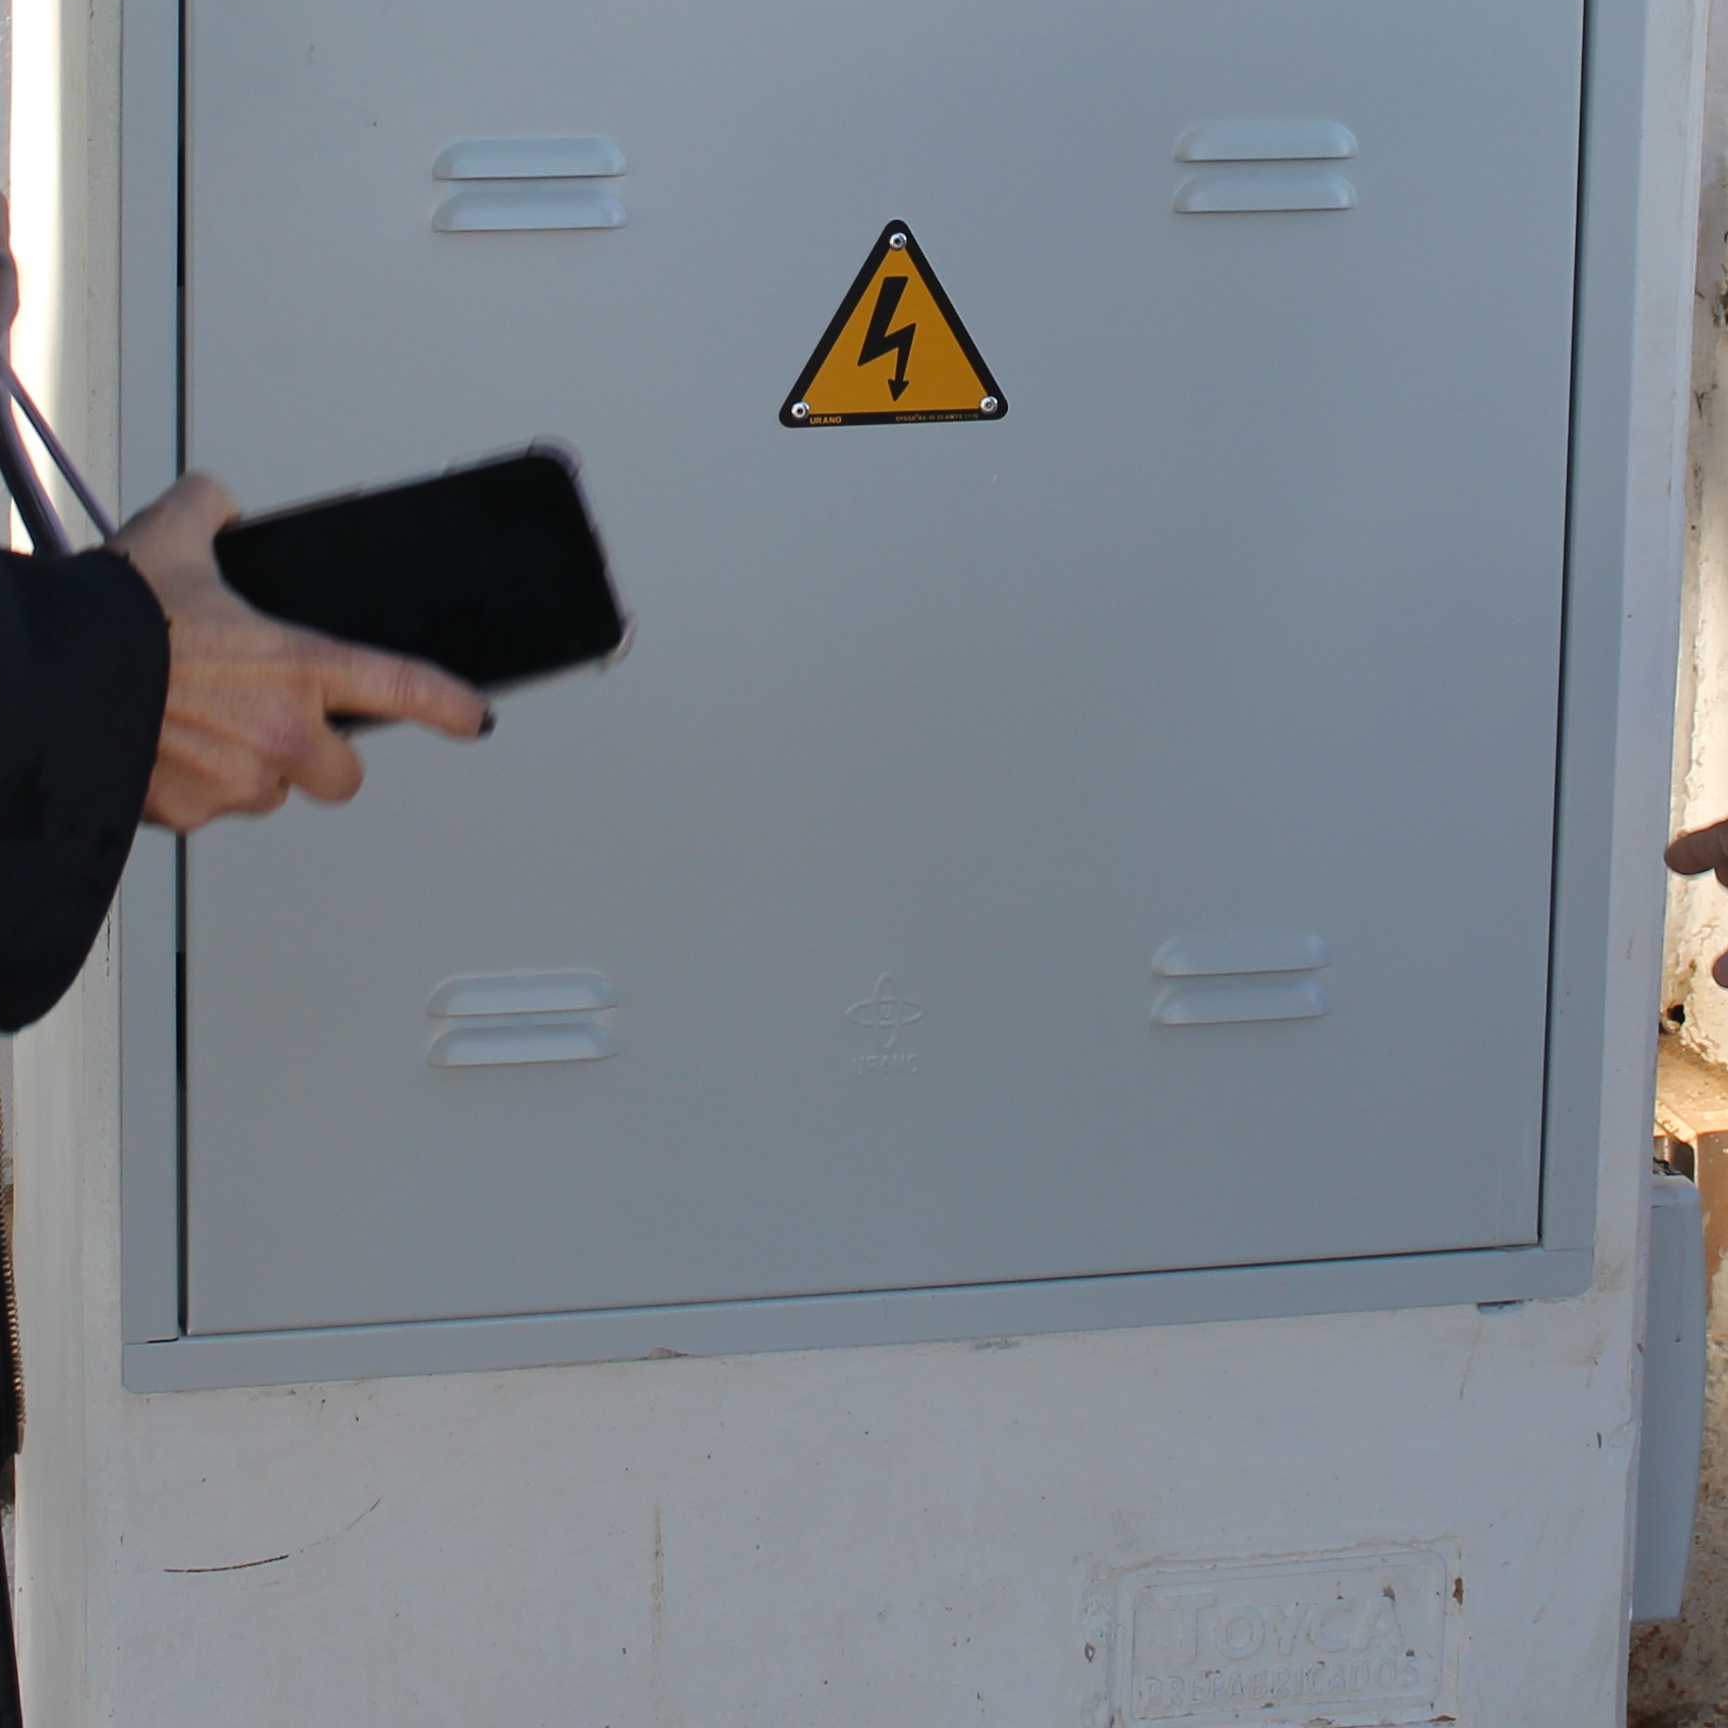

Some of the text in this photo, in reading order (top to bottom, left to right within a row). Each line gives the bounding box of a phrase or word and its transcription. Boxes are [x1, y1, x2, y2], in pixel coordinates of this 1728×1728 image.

[809, 415, 842, 424] URANO
[1162, 1590, 1406, 1664] TOYCA
[1142, 1655, 1421, 1707] PREFABRICADOS
